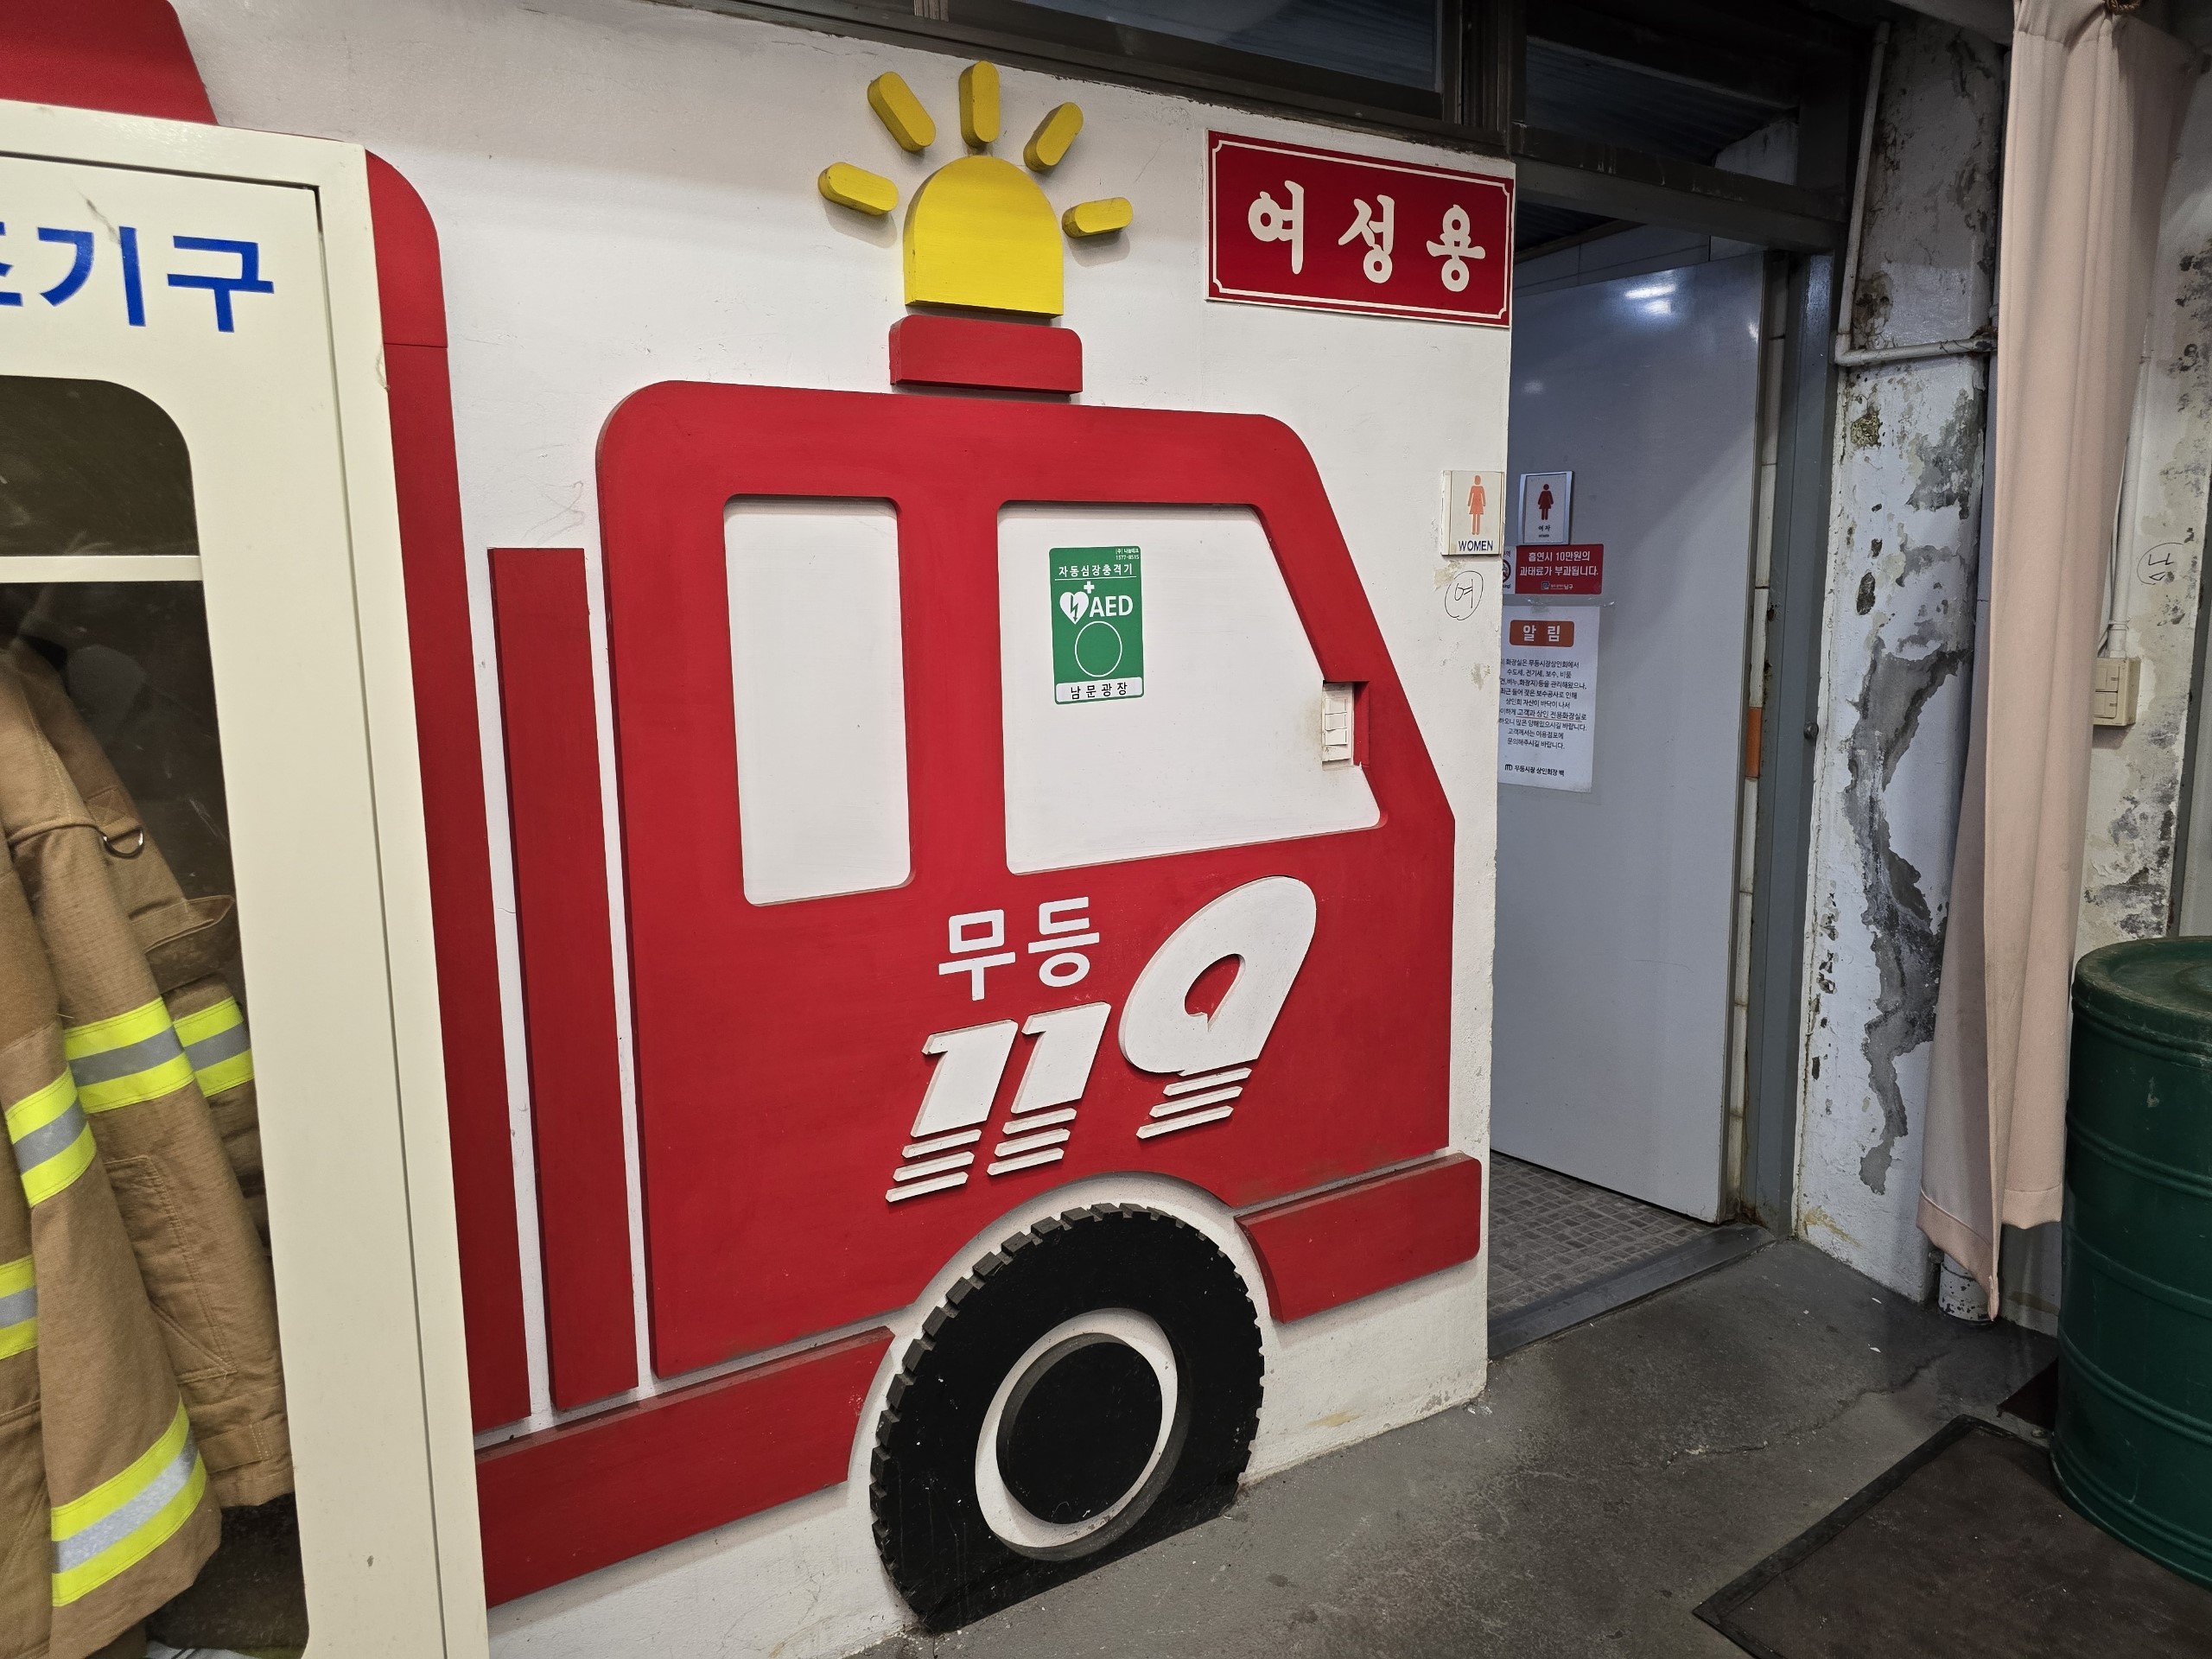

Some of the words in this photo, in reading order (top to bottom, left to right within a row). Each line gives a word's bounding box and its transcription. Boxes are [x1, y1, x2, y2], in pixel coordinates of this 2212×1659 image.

[1248, 180, 1486, 292] 여성용
[0, 221, 275, 333] 기구
[1458, 540, 1494, 552] WOMEN
[1529, 551, 1553, 562] 흡연시
[1556, 550, 1591, 562] 10만원의
[1058, 563, 1133, 578] 자동심장충격기
[1520, 566, 1553, 576] 과태료가
[1554, 565, 1599, 576] 부과됩니다.
[1089, 594, 1134, 618] AED
[1506, 658, 1528, 667] 화장실은
[1071, 682, 1128, 700] 남문광장
[1536, 709, 1548, 718] 상인
[938, 896, 1100, 1001] 무등
[885, 874, 1317, 1203] 119
